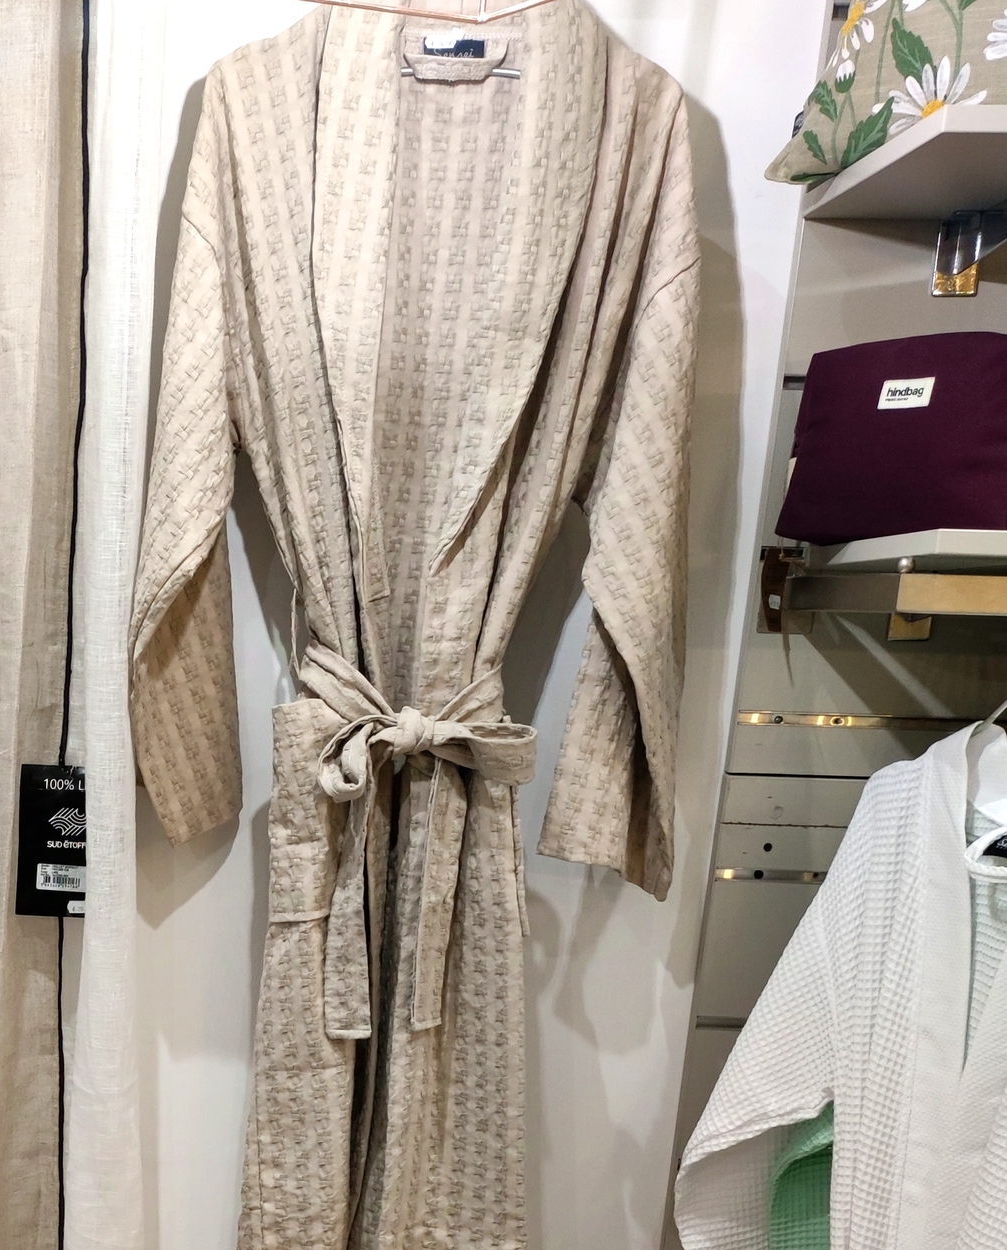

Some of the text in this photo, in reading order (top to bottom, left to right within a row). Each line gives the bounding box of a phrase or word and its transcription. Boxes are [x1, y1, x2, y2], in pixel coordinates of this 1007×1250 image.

[886, 387, 925, 398] hindbag
[44, 778, 75, 791] 100%
[47, 841, 63, 849] SUD
